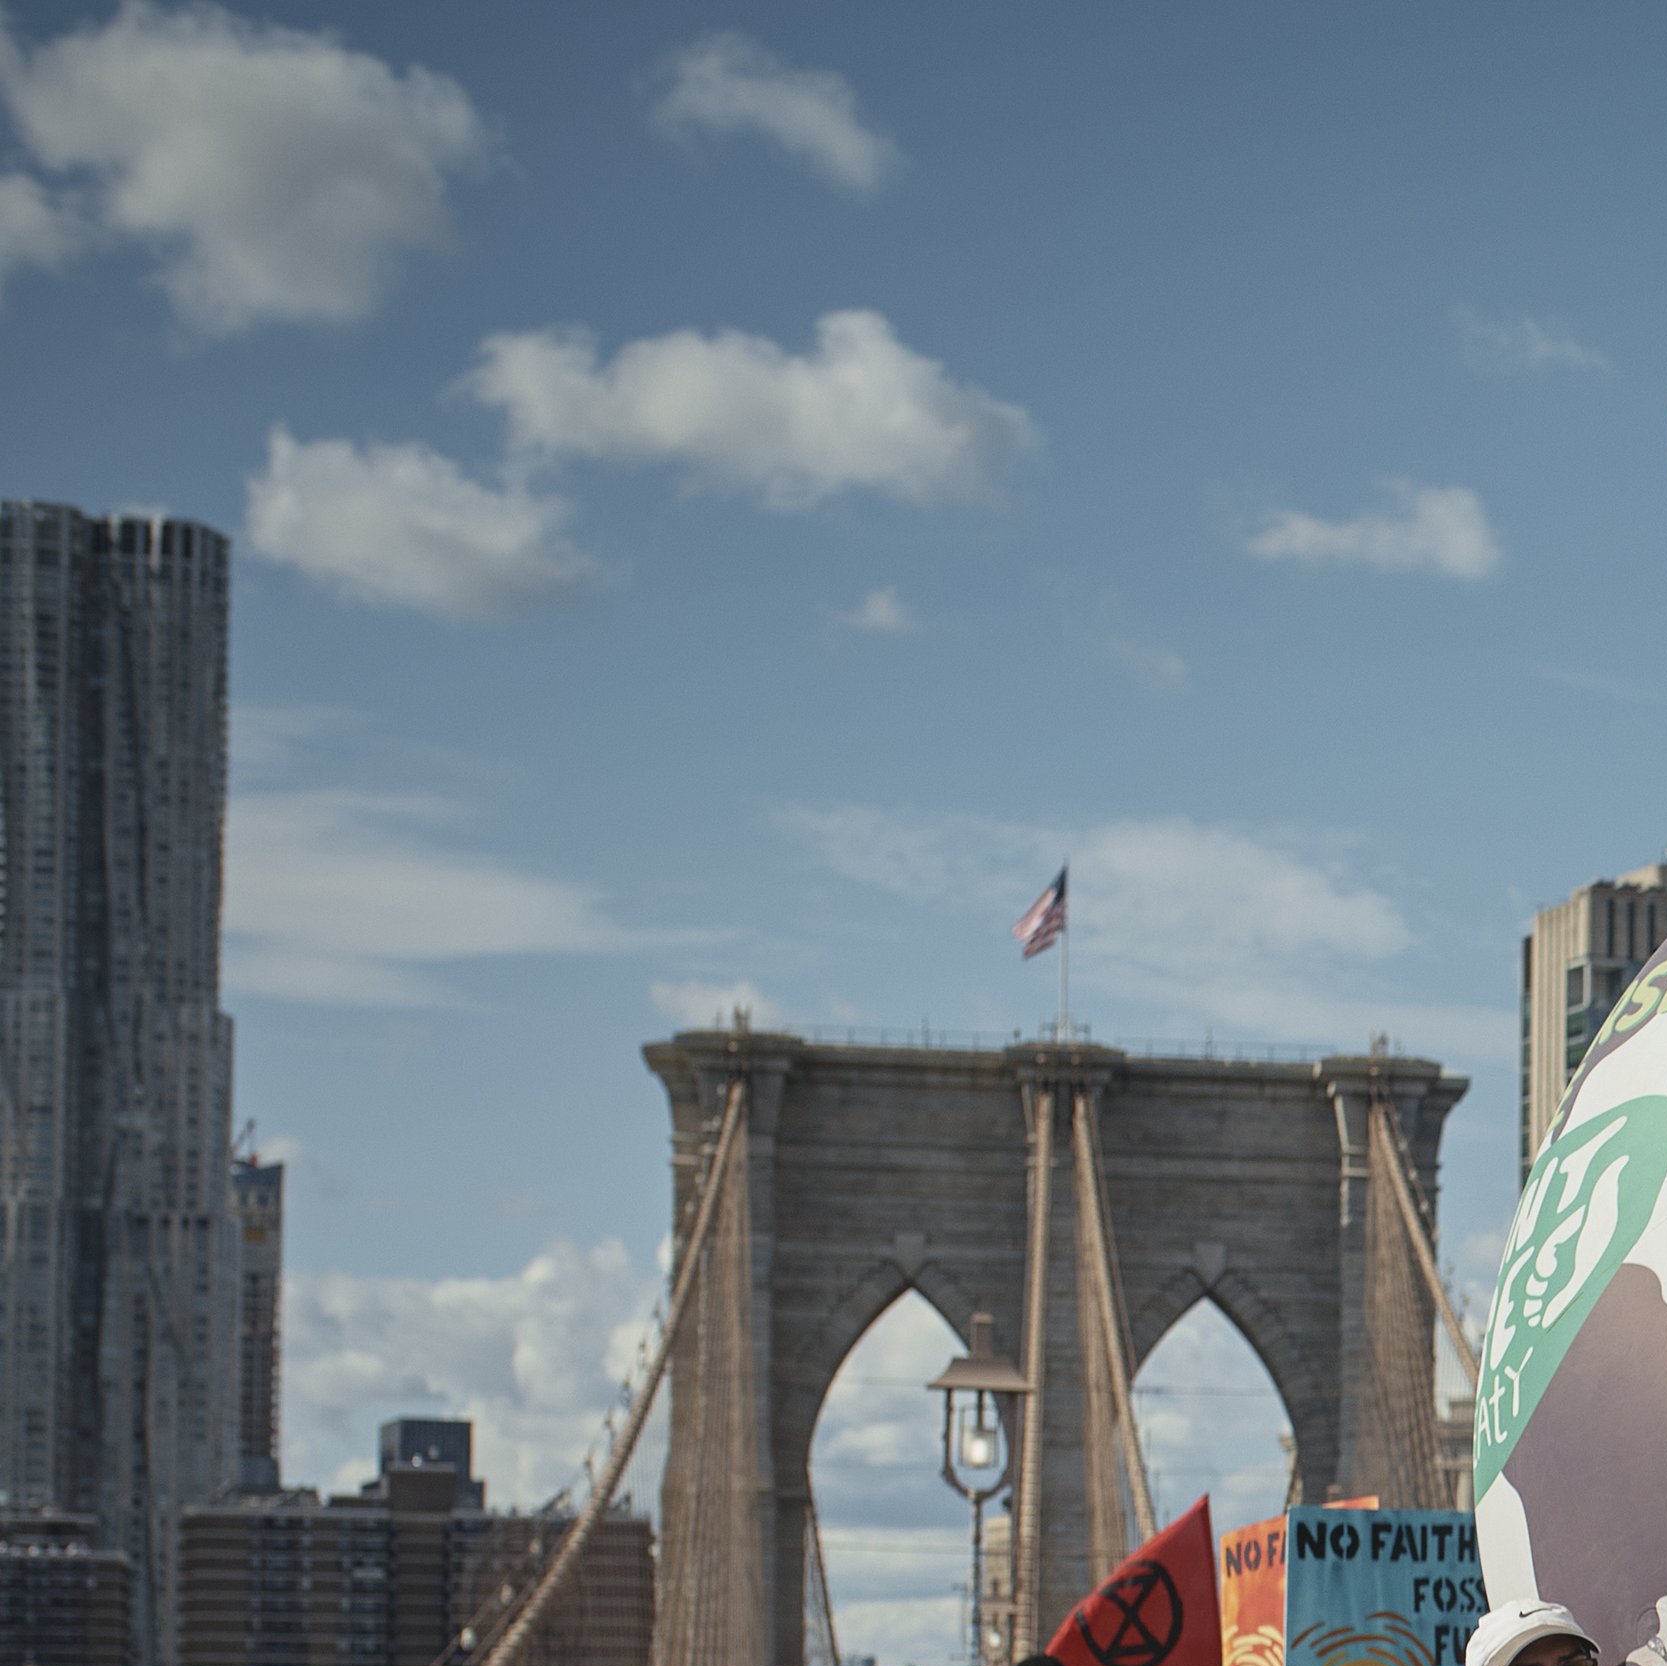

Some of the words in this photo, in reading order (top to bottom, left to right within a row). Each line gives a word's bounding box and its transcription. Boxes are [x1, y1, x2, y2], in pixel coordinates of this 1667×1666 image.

[1226, 1541, 1261, 1578] NO
[1297, 1521, 1360, 1561] NO
[1371, 1523, 1477, 1562] FAITH
